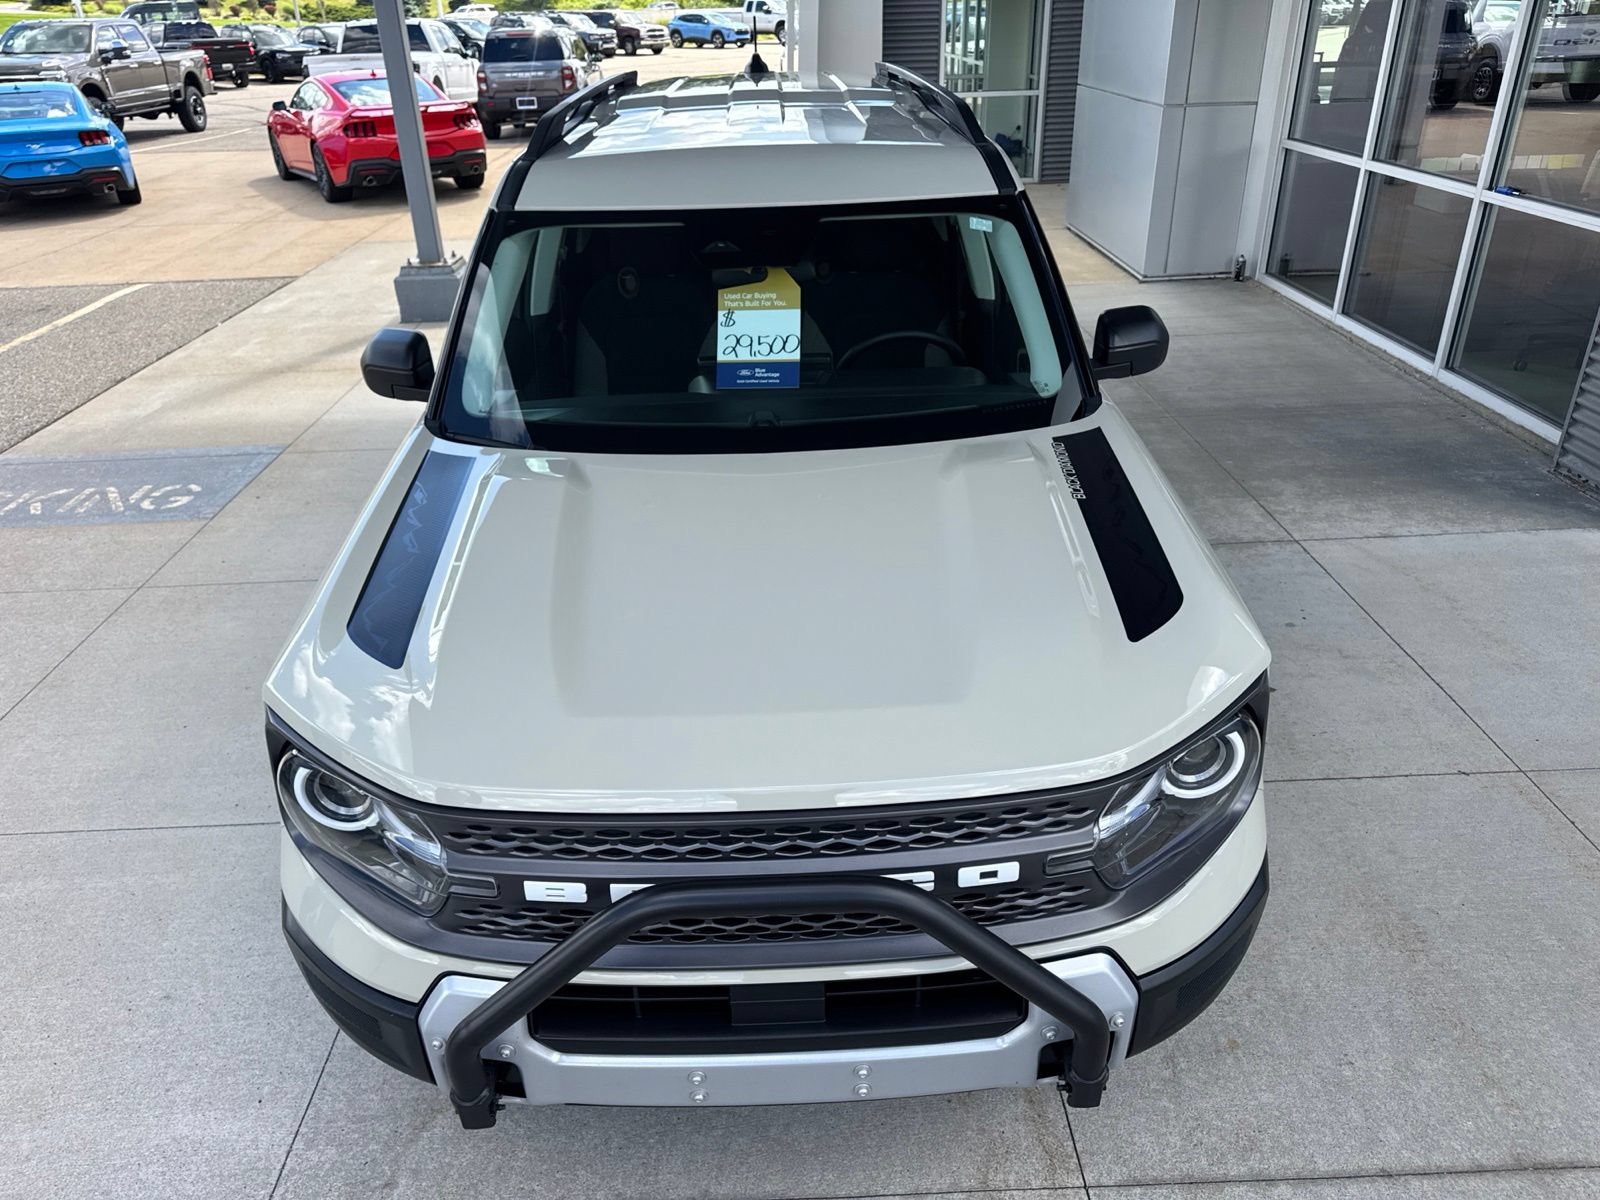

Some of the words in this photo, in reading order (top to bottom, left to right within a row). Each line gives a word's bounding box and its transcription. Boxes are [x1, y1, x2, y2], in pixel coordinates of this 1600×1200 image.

[720, 308, 736, 327] $
[722, 334, 800, 358] 29,500
[1065, 474, 1086, 499] BLACK
